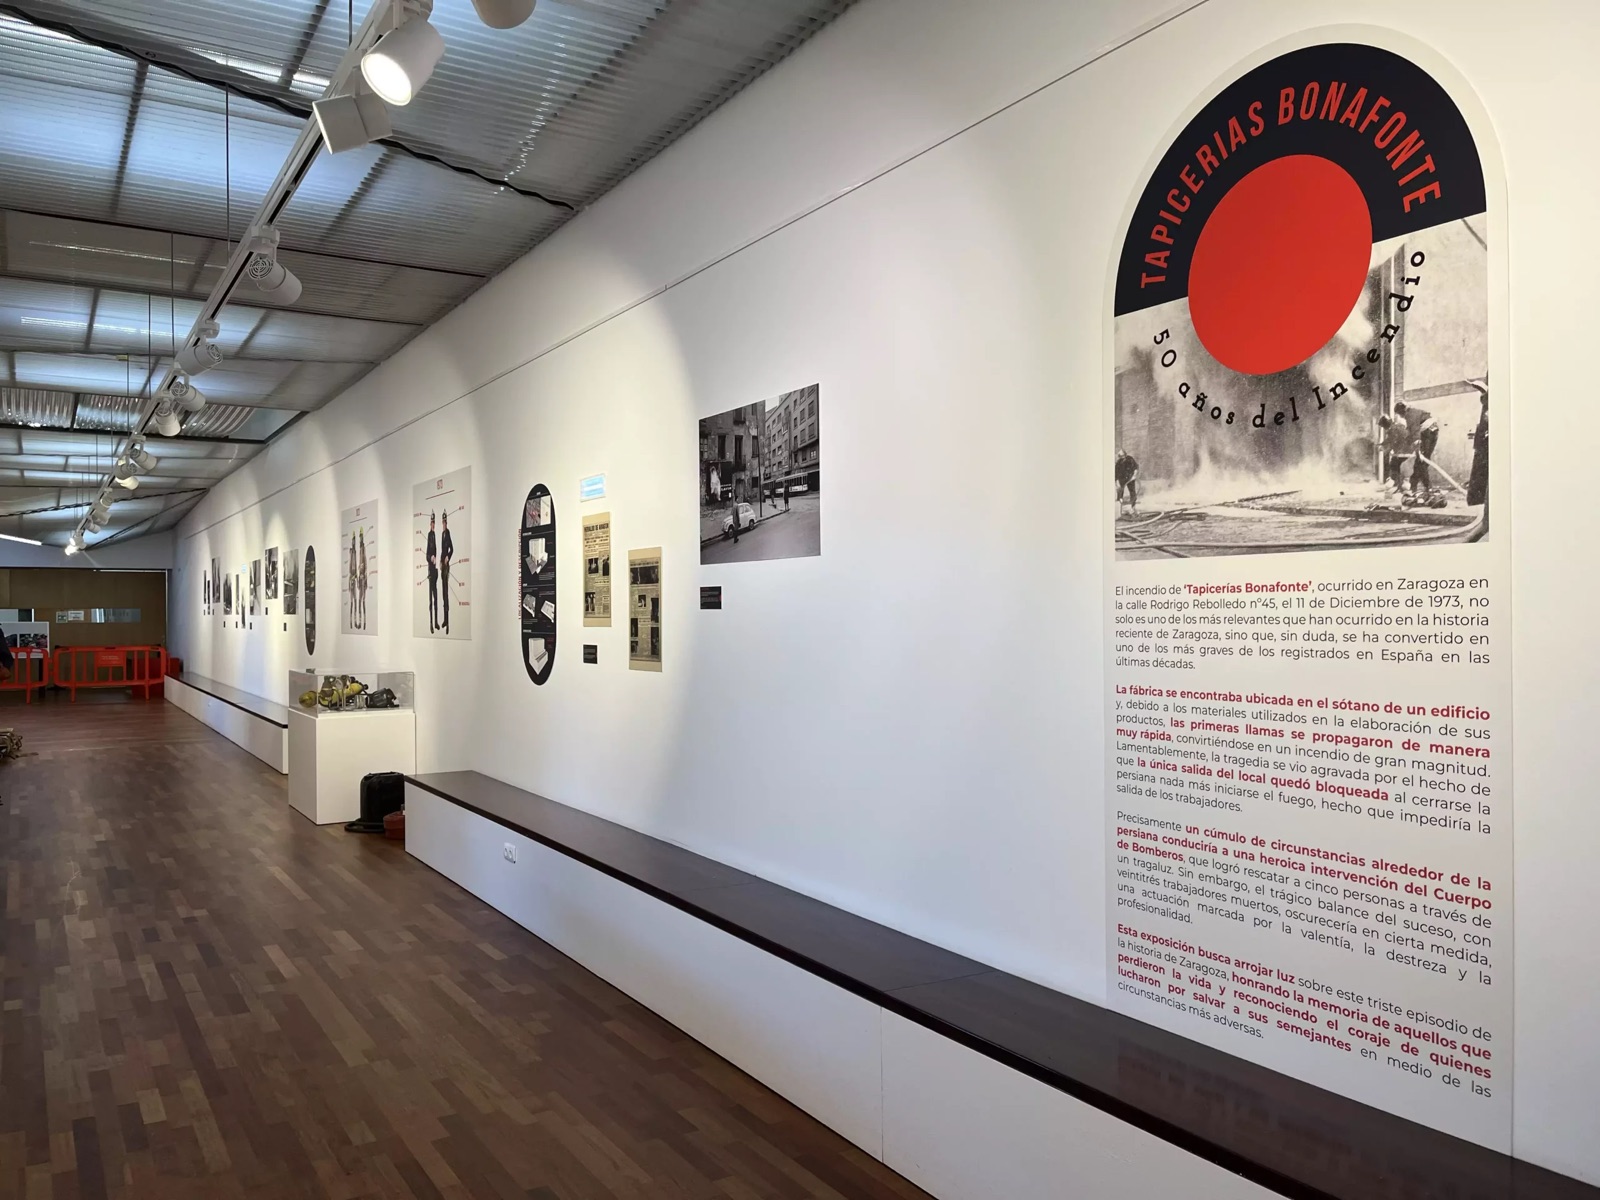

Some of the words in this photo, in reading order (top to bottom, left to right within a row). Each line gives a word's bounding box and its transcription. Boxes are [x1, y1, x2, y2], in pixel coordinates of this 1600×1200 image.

[1141, 101, 1265, 288] TAPICERIAS
[1278, 81, 1441, 213] BONAFONTE
[1153, 328, 1177, 368] 50
[1178, 382, 1235, 425] años
[1252, 395, 1300, 429] del
[1310, 250, 1425, 411] Incendio
[1115, 585, 1124, 596] El
[1125, 584, 1167, 596] incendio
[1168, 584, 1182, 595] de
[1317, 578, 1373, 592] ocurrido
[1375, 580, 1394, 591] en
[1397, 577, 1465, 593] Zaragoza
[1469, 578, 1489, 589] en
[1115, 599, 1124, 611] la
[1125, 599, 1148, 610] calle
[1150, 598, 1190, 612] Rodrigo
[1192, 598, 1247, 610] Rebolledo
[1281, 597, 1292, 609] el
[1295, 597, 1305, 609] 11
[1308, 596, 1326, 609] de
[1329, 595, 1400, 609] Diciembre
[1404, 595, 1424, 608] de
[1427, 594, 1464, 610] 1973,
[1469, 597, 1490, 608] no
[1114, 613, 1134, 625] solo
[1134, 616, 1147, 625] es
[1147, 616, 1167, 625] uno
[1167, 613, 1182, 625] de
[1182, 613, 1198, 625] los
[1198, 613, 1222, 625] más
[1223, 613, 1281, 625] relevantes
[1282, 616, 1307, 628] que
[1308, 613, 1333, 626] han
[1335, 612, 1393, 626] ocurrido
[1394, 616, 1414, 626] en
[1417, 613, 1429, 626] la
[1432, 612, 1489, 627] historia
[1115, 628, 1154, 639] reciente
[1155, 628, 1170, 640] de
[1172, 628, 1222, 642] Zaragoza,
[1224, 628, 1248, 641] sino
[1251, 631, 1277, 643] que,
[1280, 629, 1298, 642] sin
[1302, 629, 1339, 644] duda,
[1342, 633, 1358, 643] se
[1362, 630, 1379, 643] ha
[1384, 631, 1464, 645] convertido
[1469, 634, 1489, 646] en
[1115, 644, 1134, 653] uno
[1137, 642, 1151, 653] de
[1154, 642, 1169, 654] los
[1172, 643, 1195, 655] más
[1198, 646, 1234, 658] graves
[1238, 644, 1254, 657] de
[1258, 645, 1276, 658] los
[1280, 646, 1350, 661] registrados
[1356, 650, 1374, 661] en
[1381, 648, 1433, 664] España
[1440, 652, 1460, 664] en
[1469, 650, 1491, 664] las
[1115, 655, 1151, 668] últimas
[1151, 657, 1196, 670] décadas.
[1115, 684, 1127, 695] La
[1128, 684, 1164, 698] fábrica
[1165, 689, 1178, 698] se
[1179, 690, 1243, 703] encontraba
[1245, 692, 1294, 707] ubicada
[1296, 698, 1314, 708] en
[1316, 697, 1329, 709] el
[1331, 698, 1381, 713] sótano
[1383, 701, 1403, 715] de
[1406, 705, 1427, 717] un
[1430, 704, 1491, 721] edificio
[1116, 713, 1166, 728] productos,
[1170, 716, 1186, 729] las
[1190, 718, 1240, 734] primeras
[1245, 723, 1285, 739] llamas
[1290, 730, 1306, 741] se
[1312, 732, 1394, 749] propagaron
[1401, 738, 1421, 752] de
[1429, 743, 1491, 759] manera
[1116, 728, 1138, 740] muy
[1140, 728, 1174, 744] rápida,
[1176, 734, 1255, 752] convirtiéndose
[1256, 743, 1272, 753] en
[1275, 745, 1292, 756] un
[1295, 744, 1350, 762] incendio
[1353, 750, 1371, 764] de
[1374, 755, 1407, 769] gran
[1411, 759, 1491, 778] magnitud.
[1116, 756, 1135, 767] que
[1137, 756, 1147, 768] la
[1149, 758, 1178, 772] única
[1181, 763, 1213, 777] salida
[1216, 767, 1235, 780] del
[1238, 769, 1267, 785] local
[1270, 776, 1311, 791] quedó
[1315, 779, 1389, 802] bloqueada
[1394, 791, 1406, 804] al
[1411, 795, 1472, 813] cerrarse
[1478, 800, 1491, 816] la
[1116, 783, 1143, 796] salida
[1144, 786, 1158, 799] de
[1159, 788, 1174, 801] los
[1175, 792, 1243, 813] trabajadores.
[1116, 810, 1182, 832] Precisamente
[1185, 825, 1200, 836] un
[1203, 827, 1247, 844] cúmulo
[1250, 835, 1267, 848] de
[1270, 838, 1366, 867] circunstancias
[1371, 858, 1445, 882] alrededor
[1450, 872, 1471, 888] de
[1477, 876, 1492, 891] la
[1116, 826, 1159, 842] persiana
[1161, 835, 1218, 855] conduciría
[1221, 847, 1229, 857] a
[1233, 849, 1256, 862] una
[1259, 851, 1306, 873] heroica
[1310, 861, 1399, 892] intervención
[1403, 881, 1428, 898] del
[1433, 887, 1492, 910] Cuerpo
[1117, 897, 1193, 925] profesionalidad.
[1117, 923, 1138, 938] Esta
[1140, 931, 1195, 955] exposición
[1197, 945, 1231, 966] busca
[1233, 958, 1274, 978] arrojar
[1276, 968, 1296, 985] luz
[1298, 977, 1333, 996] sobre
[1336, 989, 1364, 1005] este
[1366, 996, 1403, 1016] triste
[1406, 1009, 1468, 1035] episodio
[1472, 1026, 1492, 1042] de
[1117, 953, 1166, 976] perdieron
[1172, 967, 1182, 981] la
[1188, 974, 1212, 991] vida
[1218, 984, 1227, 997] y
[1233, 989, 1318, 1024] reconociendo
[1326, 1019, 1339, 1031] el
[1347, 1026, 1391, 1048] coraje
[1400, 1041, 1420, 1057] de
[1429, 1052, 1492, 1079] quienes
